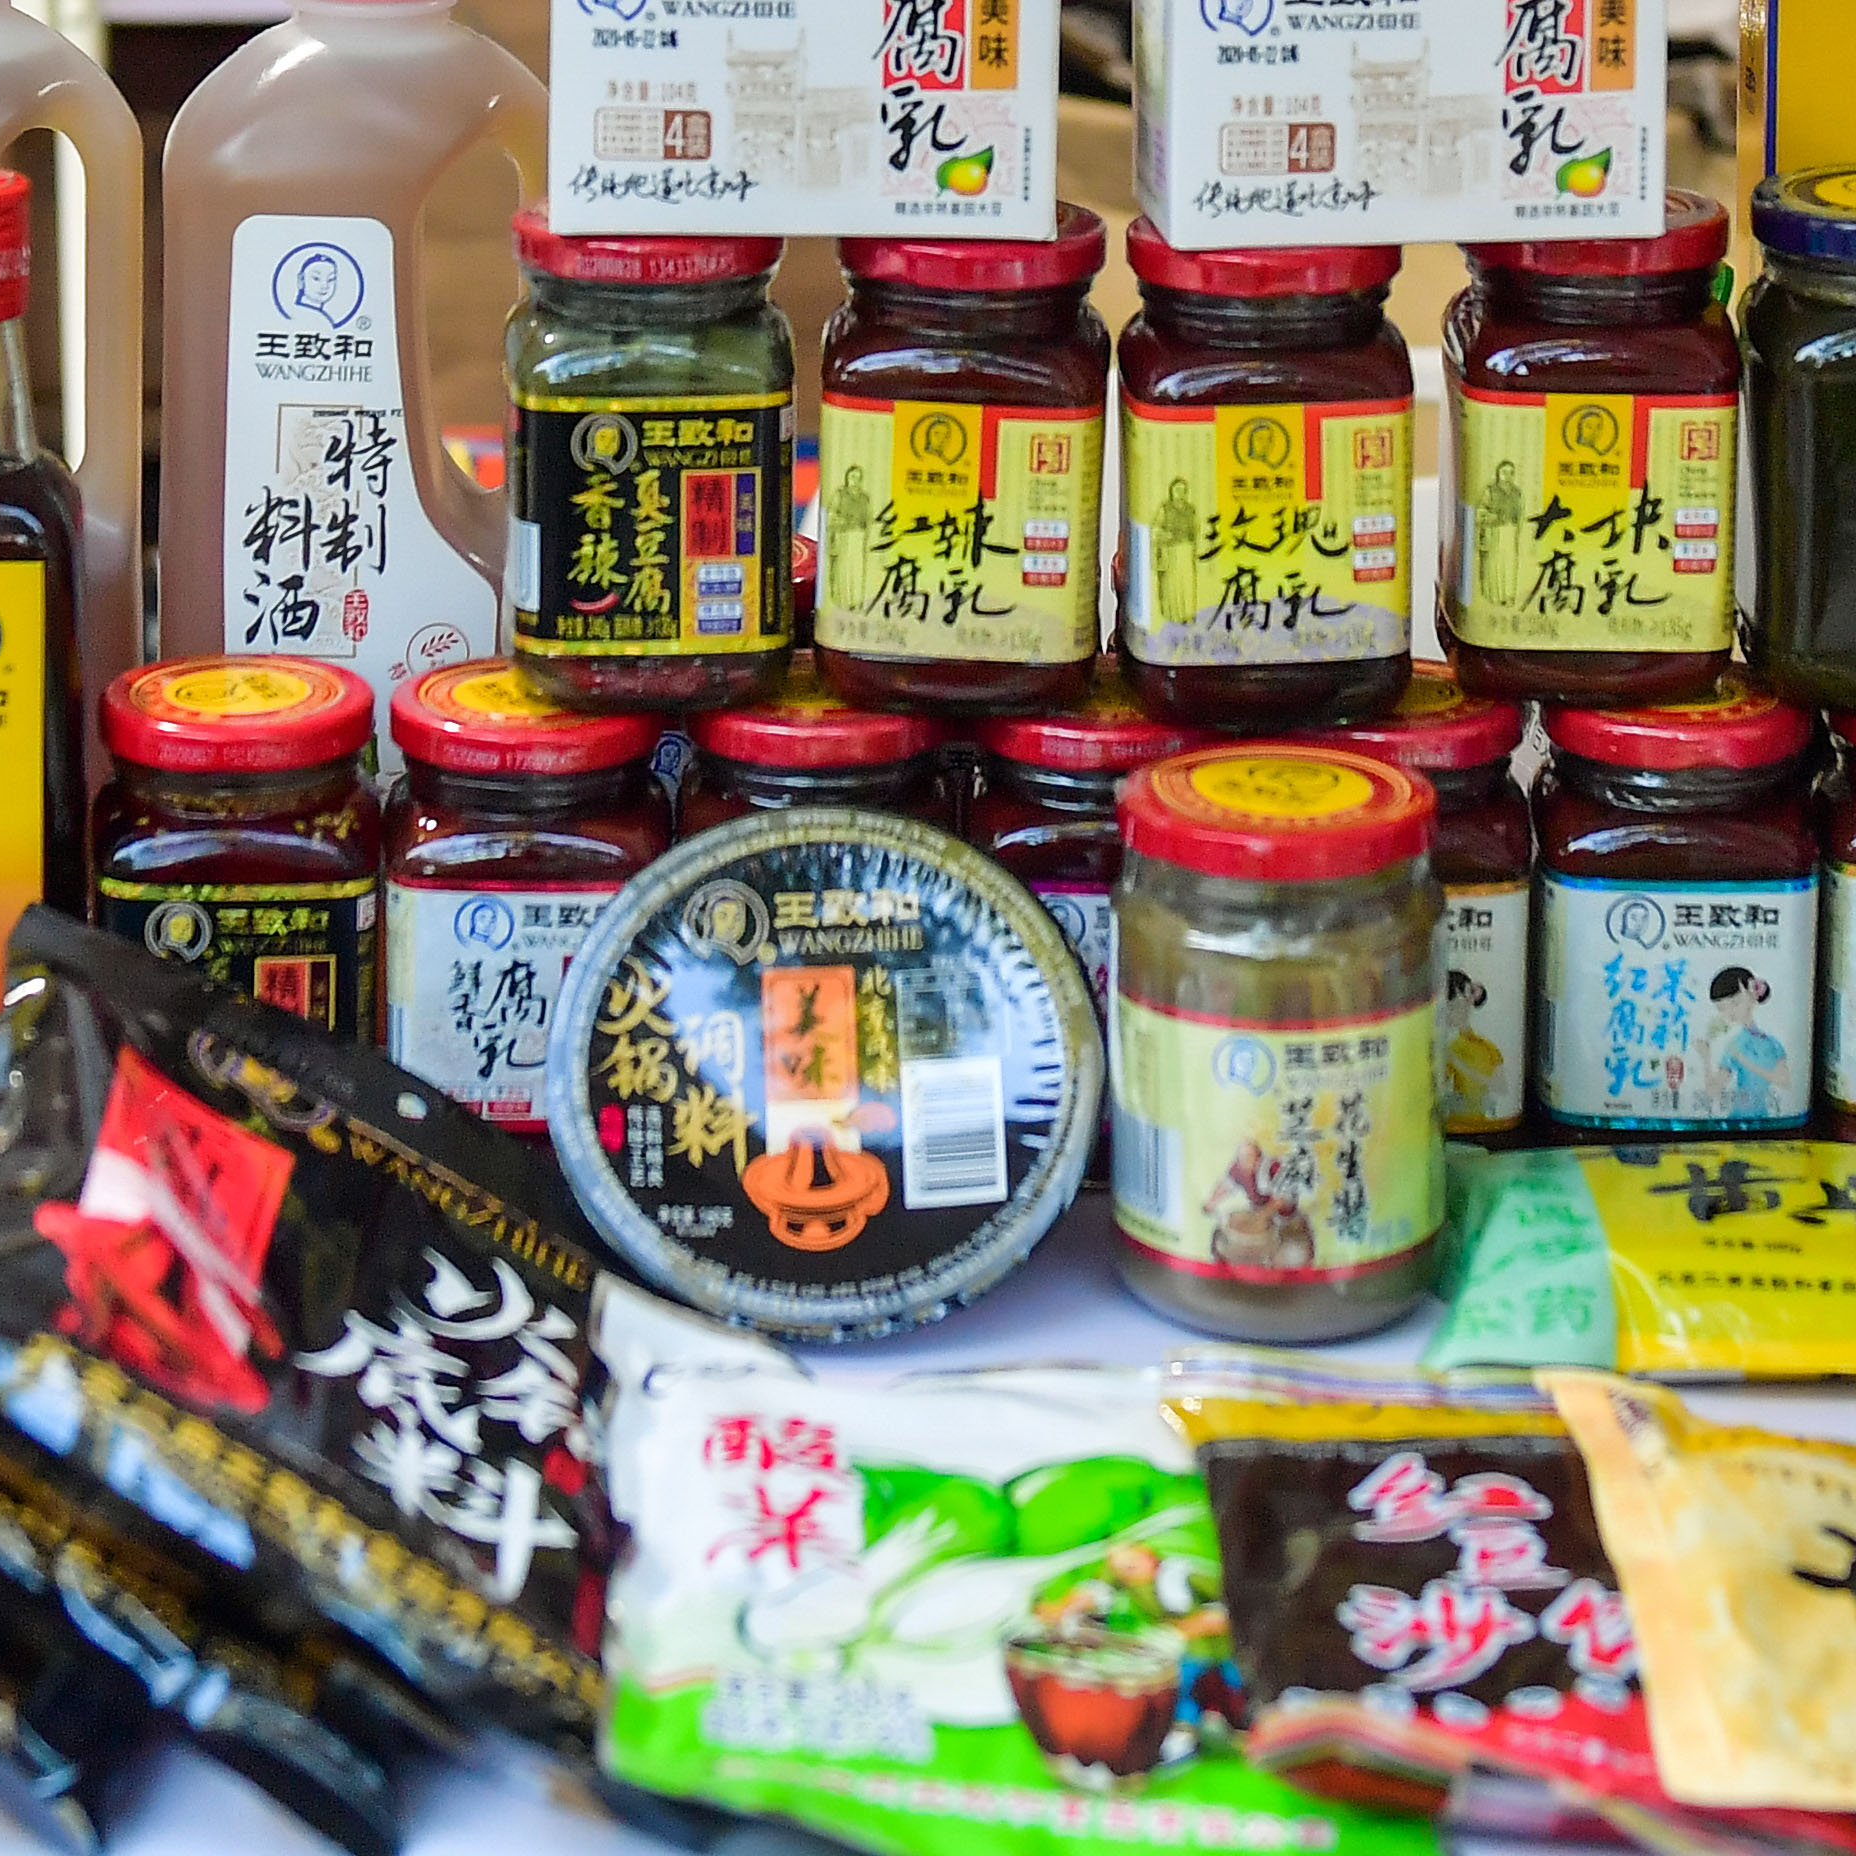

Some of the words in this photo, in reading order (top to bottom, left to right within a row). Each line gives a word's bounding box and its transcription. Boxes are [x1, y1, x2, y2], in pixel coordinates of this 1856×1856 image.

[662, 0, 797, 20] WANGZHIHE
[1287, 12, 1421, 32] WANGZHIHE
[255, 332, 373, 361] 王致和
[256, 364, 373, 383] WANGZHIHE
[641, 420, 755, 447] 王致和
[320, 412, 398, 577] 特制
[569, 472, 629, 592] 香辣
[1198, 505, 1352, 563] 玫瑰
[242, 484, 321, 646] 料酒
[1520, 550, 1672, 619] 腐乳
[866, 555, 1017, 627] 腐乳
[1207, 563, 1357, 632] 腐乳
[523, 903, 602, 929] 王致
[773, 889, 921, 929] 王致和
[1674, 903, 1780, 929] 王致和
[590, 953, 681, 1105] 火锅
[1284, 1035, 1390, 1068] 王致和
